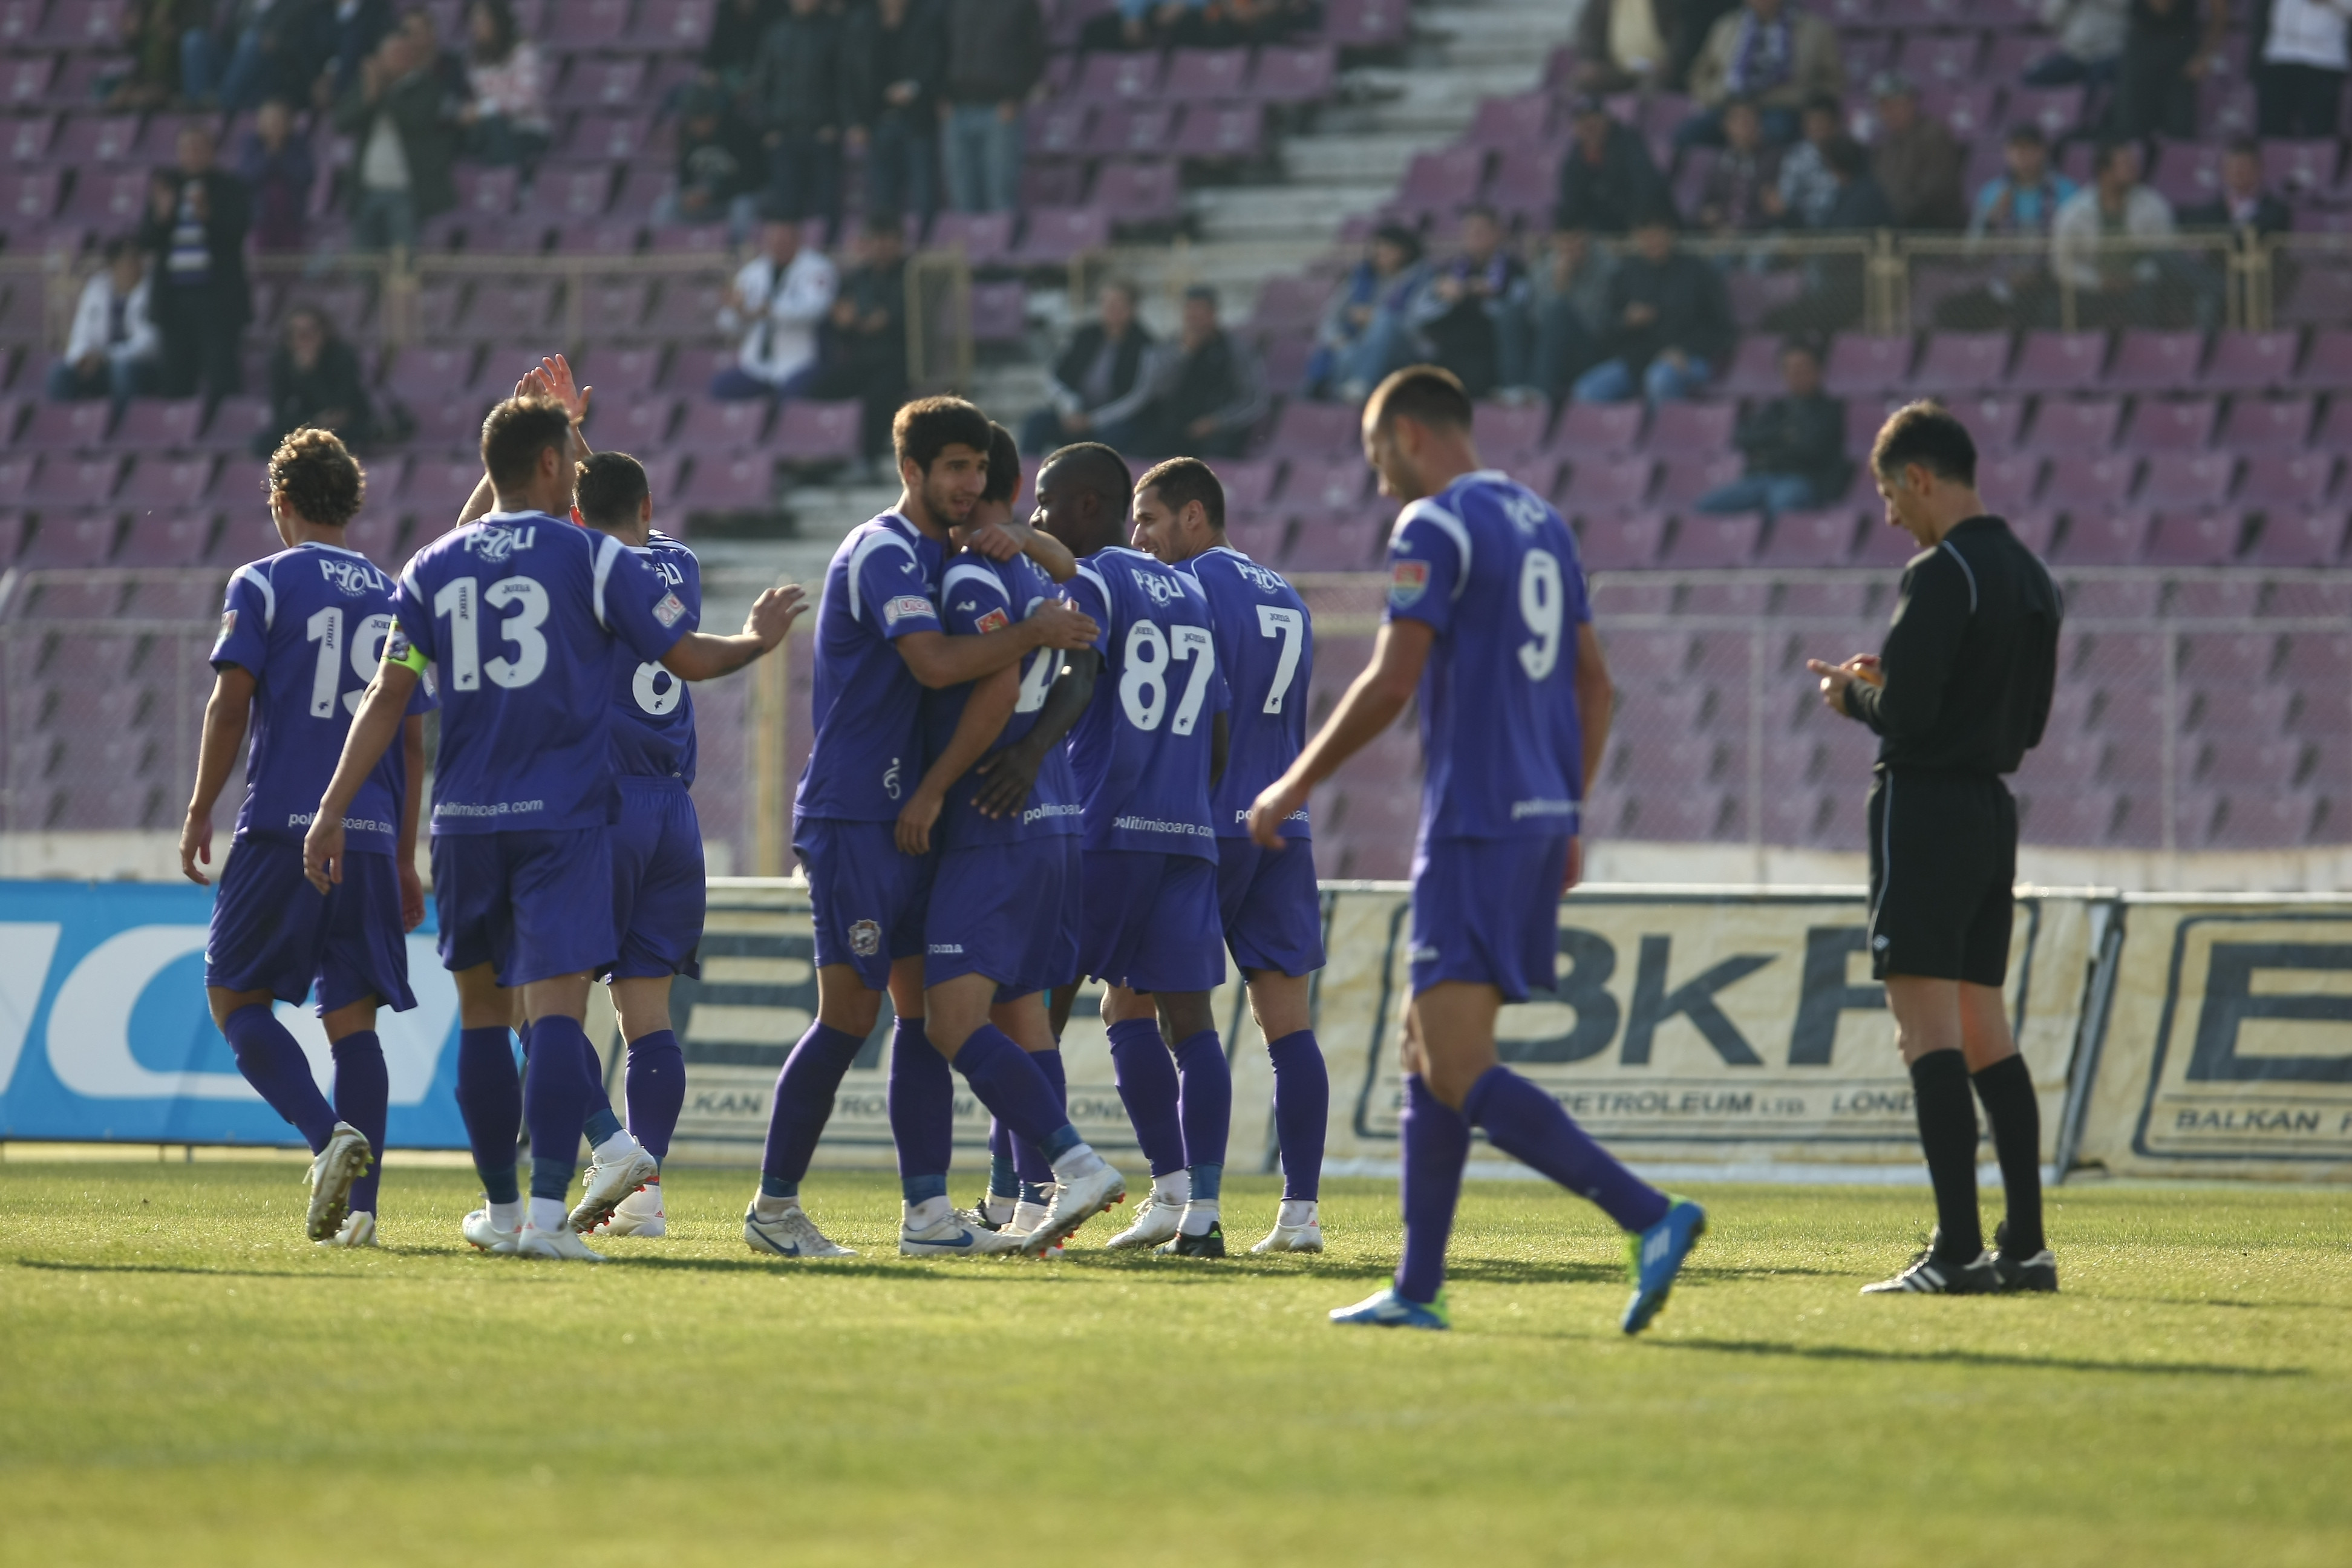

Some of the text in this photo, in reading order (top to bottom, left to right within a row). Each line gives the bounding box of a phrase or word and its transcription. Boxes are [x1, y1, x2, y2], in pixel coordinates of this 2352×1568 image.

[434, 575, 550, 691] 13
[1256, 604, 1303, 714] 7
[1517, 548, 1564, 681] 9
[1119, 618, 1215, 736] 87
